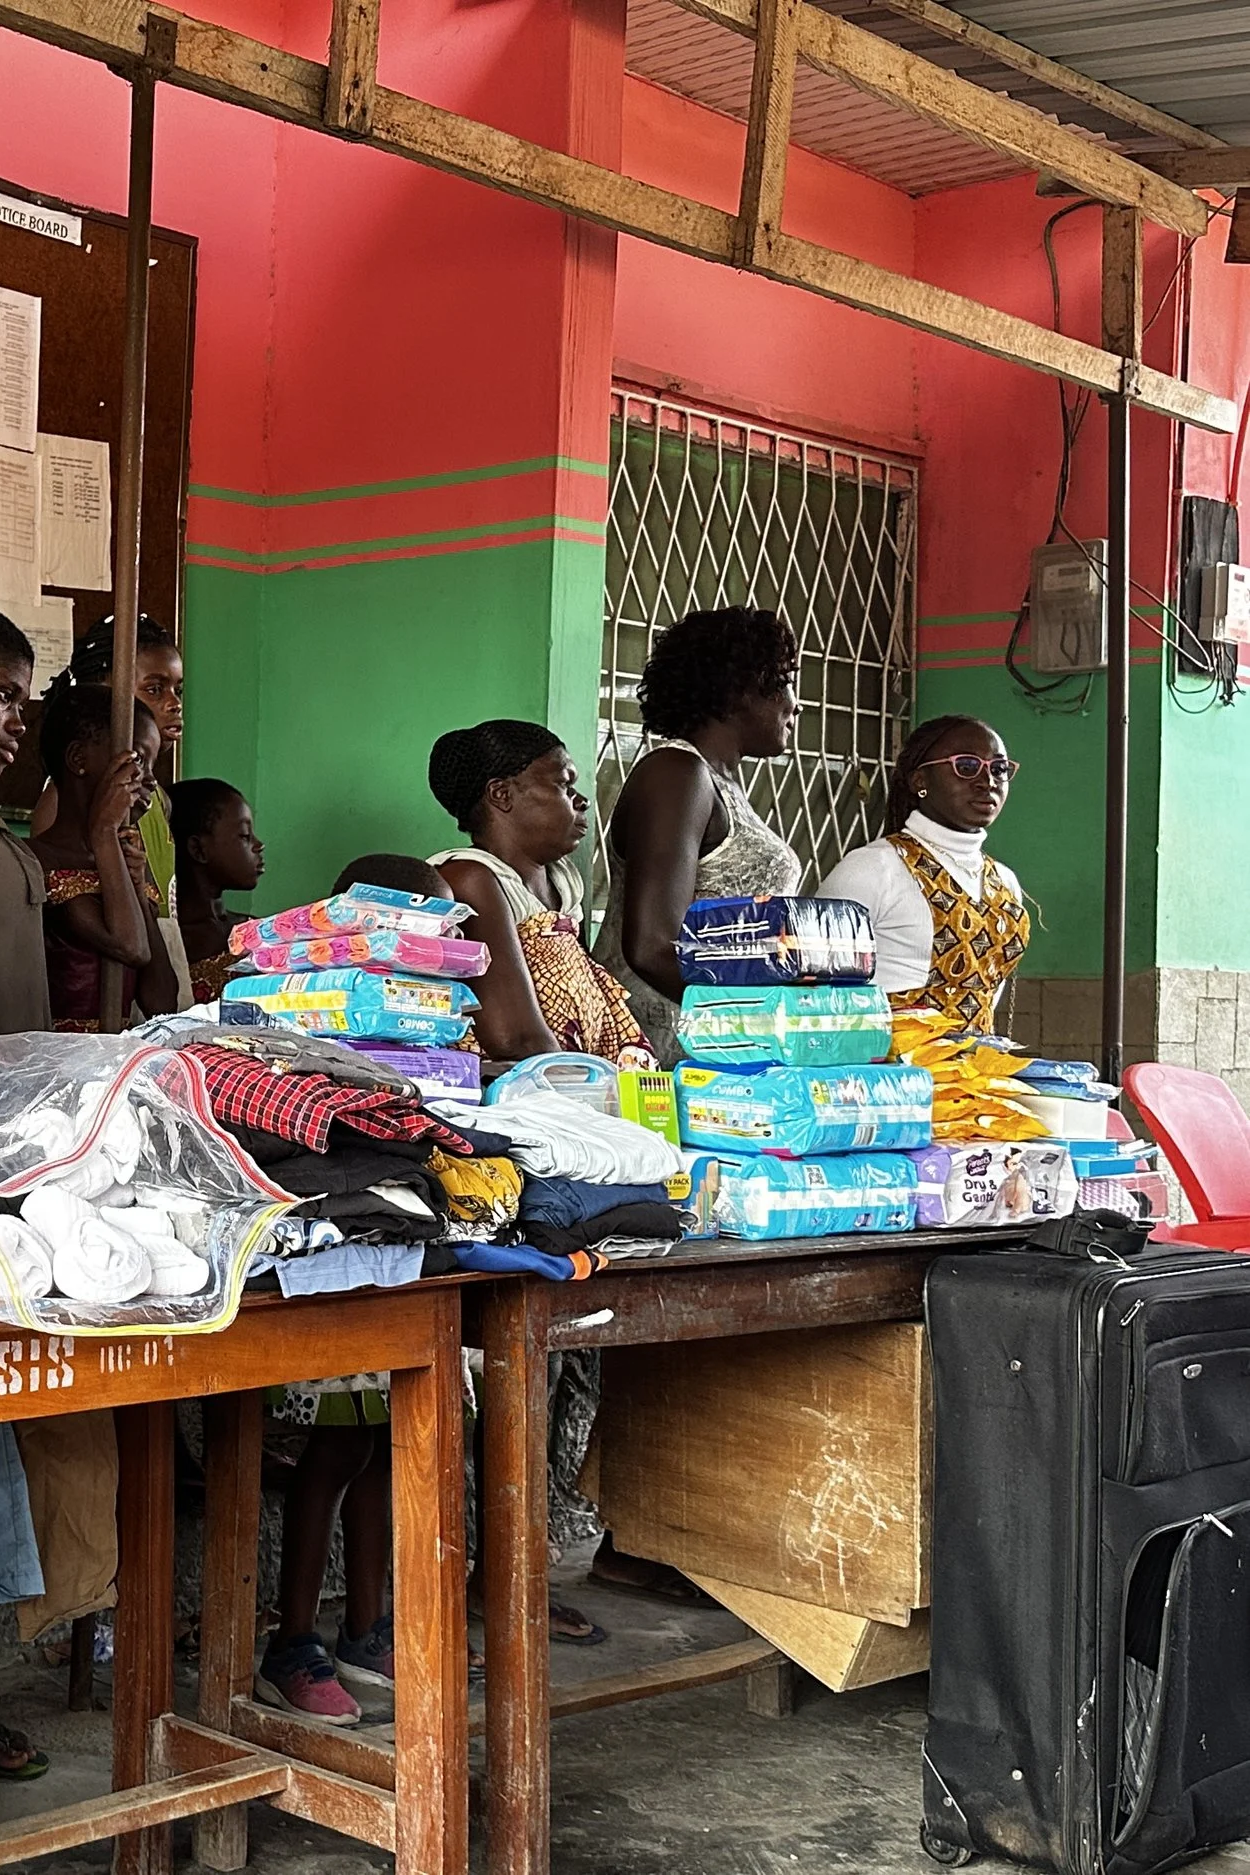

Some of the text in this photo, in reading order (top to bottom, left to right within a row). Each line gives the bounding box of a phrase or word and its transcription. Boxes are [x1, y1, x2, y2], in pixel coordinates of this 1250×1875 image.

[29, 216, 68, 239] BOARD
[398, 1017, 436, 1032] COMBO
[673, 1177, 690, 1186] PACK
[964, 1179, 997, 1192] Dry &
